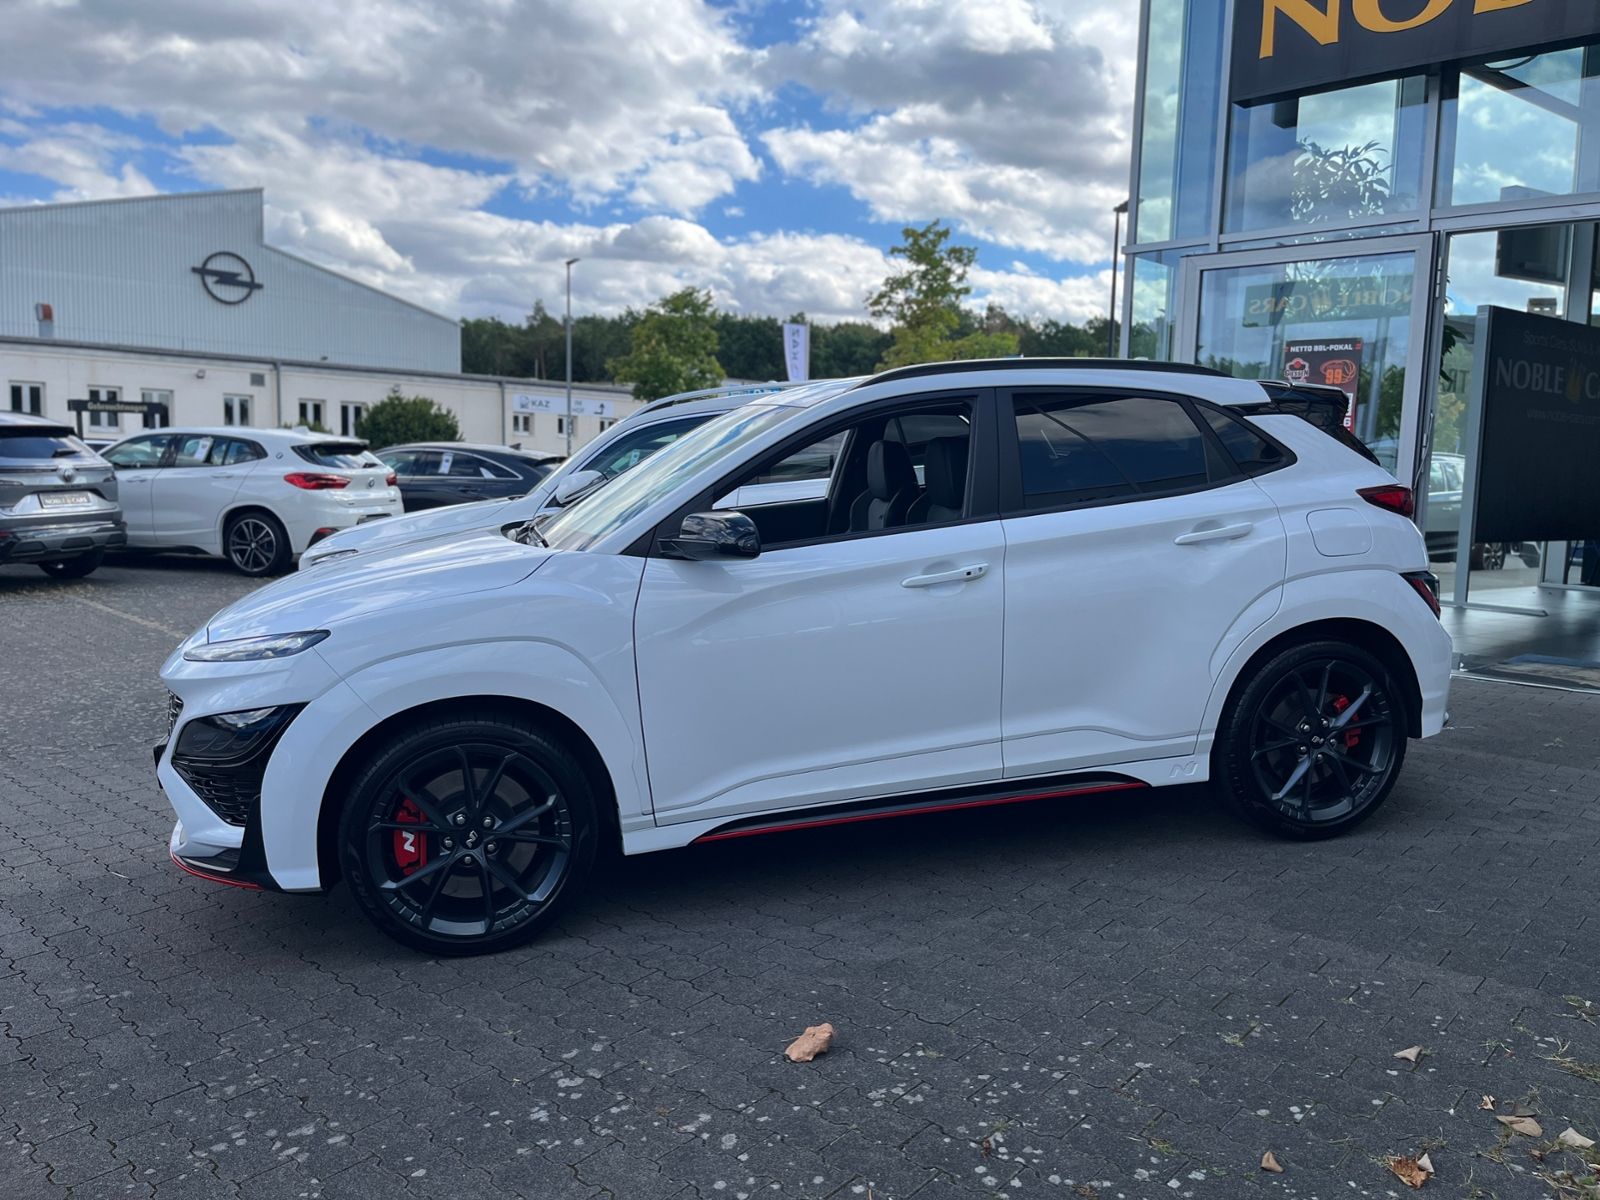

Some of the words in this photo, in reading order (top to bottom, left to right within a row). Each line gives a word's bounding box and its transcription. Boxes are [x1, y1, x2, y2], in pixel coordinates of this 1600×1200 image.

[1289, 345, 1312, 353] NETTO
[1325, 368, 1343, 385] 99
[1495, 356, 1564, 395] NOBLE
[531, 399, 551, 408] KAZ
